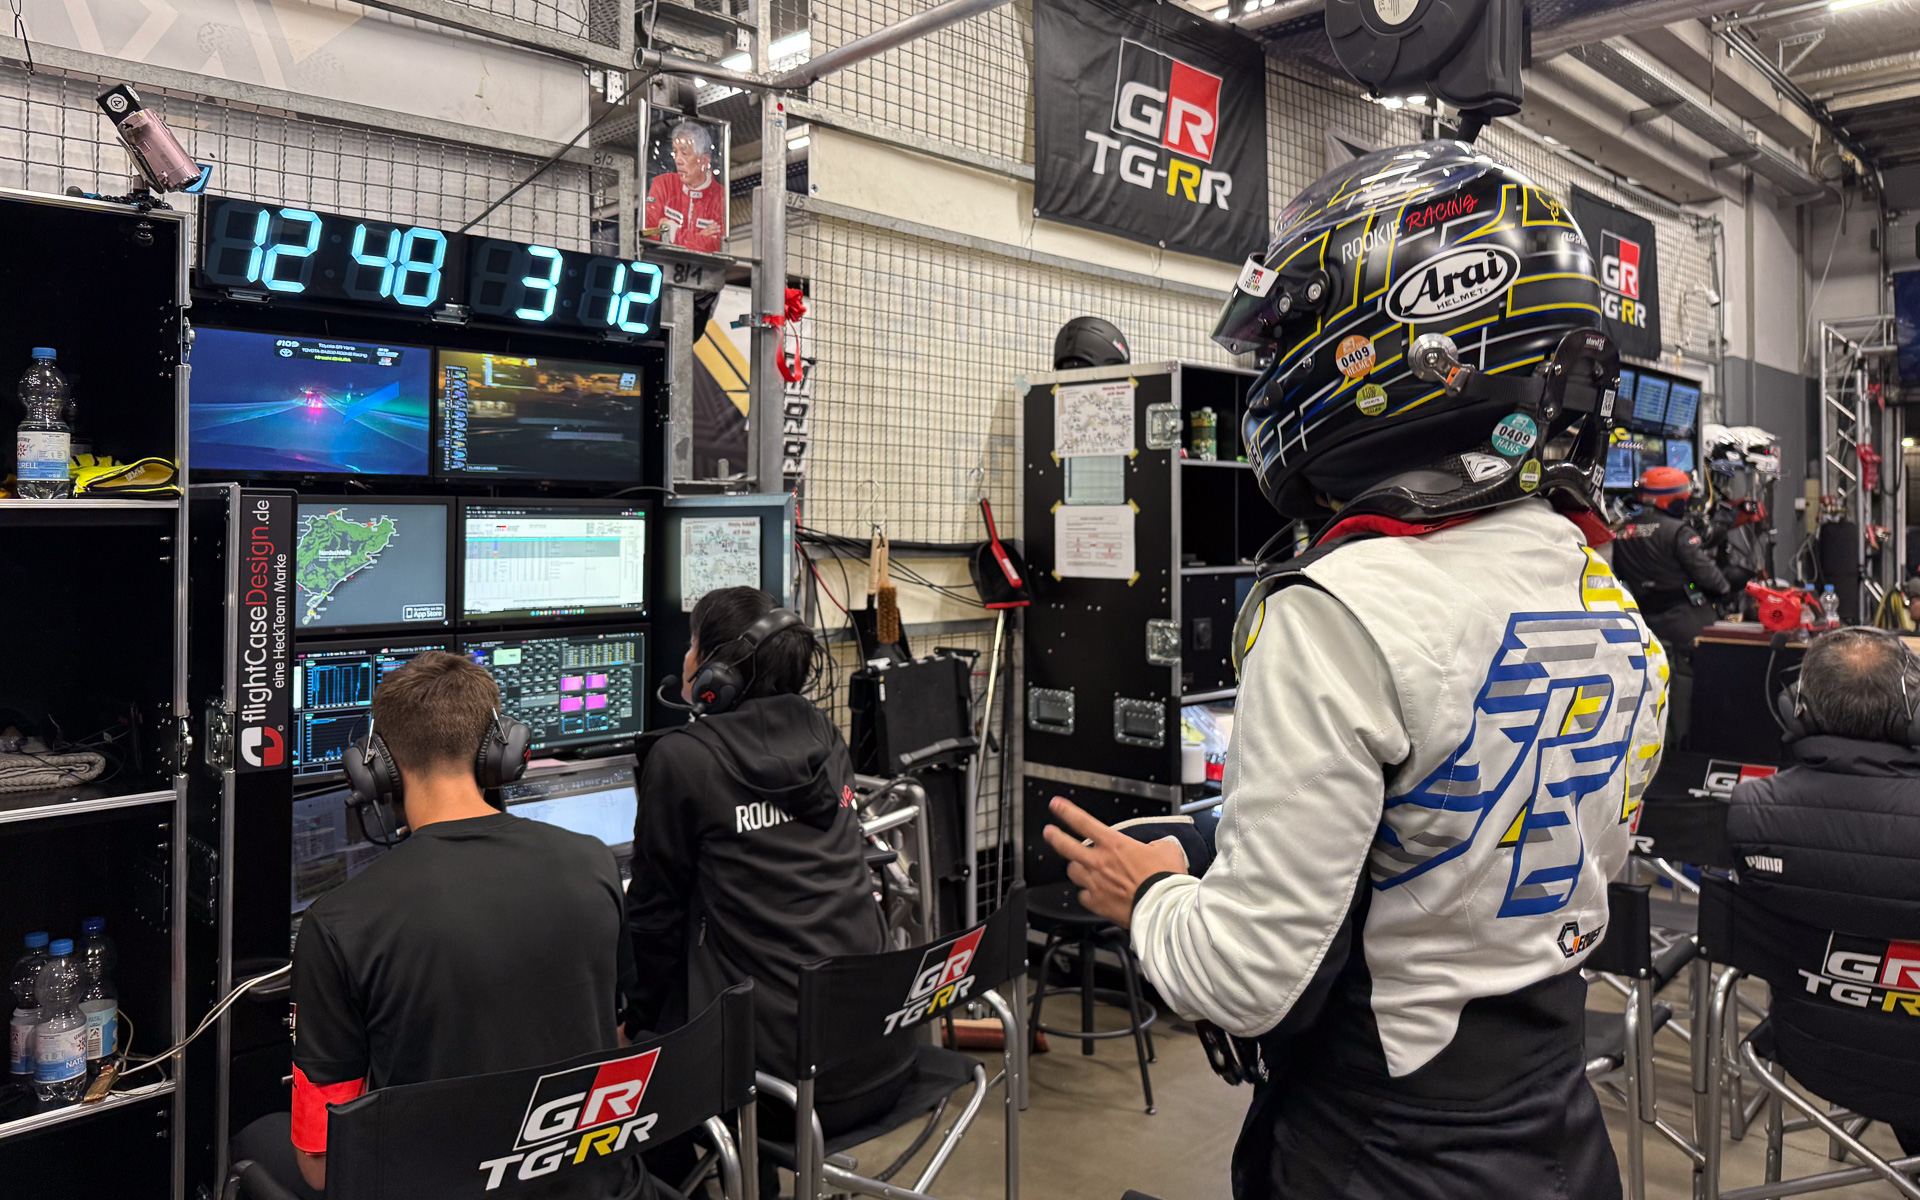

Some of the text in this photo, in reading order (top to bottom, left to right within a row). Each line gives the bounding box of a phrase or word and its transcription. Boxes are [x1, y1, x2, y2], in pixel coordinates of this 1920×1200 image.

[1117, 81, 1214, 156] GR
[1085, 130, 1233, 211] TG-RR
[1341, 194, 1478, 265] ROOKIE RACING
[247, 208, 662, 334] 12 48 3 12
[673, 263, 703, 286] 8/1
[1400, 250, 1504, 316] Arai
[1436, 289, 1484, 312] HELMET
[1602, 254, 1638, 296] GR
[1341, 346, 1370, 368] 0409
[1496, 438, 1520, 454] HANS
[1499, 425, 1531, 446] 0409
[242, 499, 274, 722] flightCaseDesign.de
[272, 553, 287, 688] eine HeckTeam Marke
[414, 610, 443, 619] App Store
[1745, 854, 1783, 874] PUMA
[911, 949, 972, 999] GR
[883, 975, 976, 1036] TG-RR
[523, 1079, 643, 1142] GR
[478, 1113, 659, 1191] TG-RR
